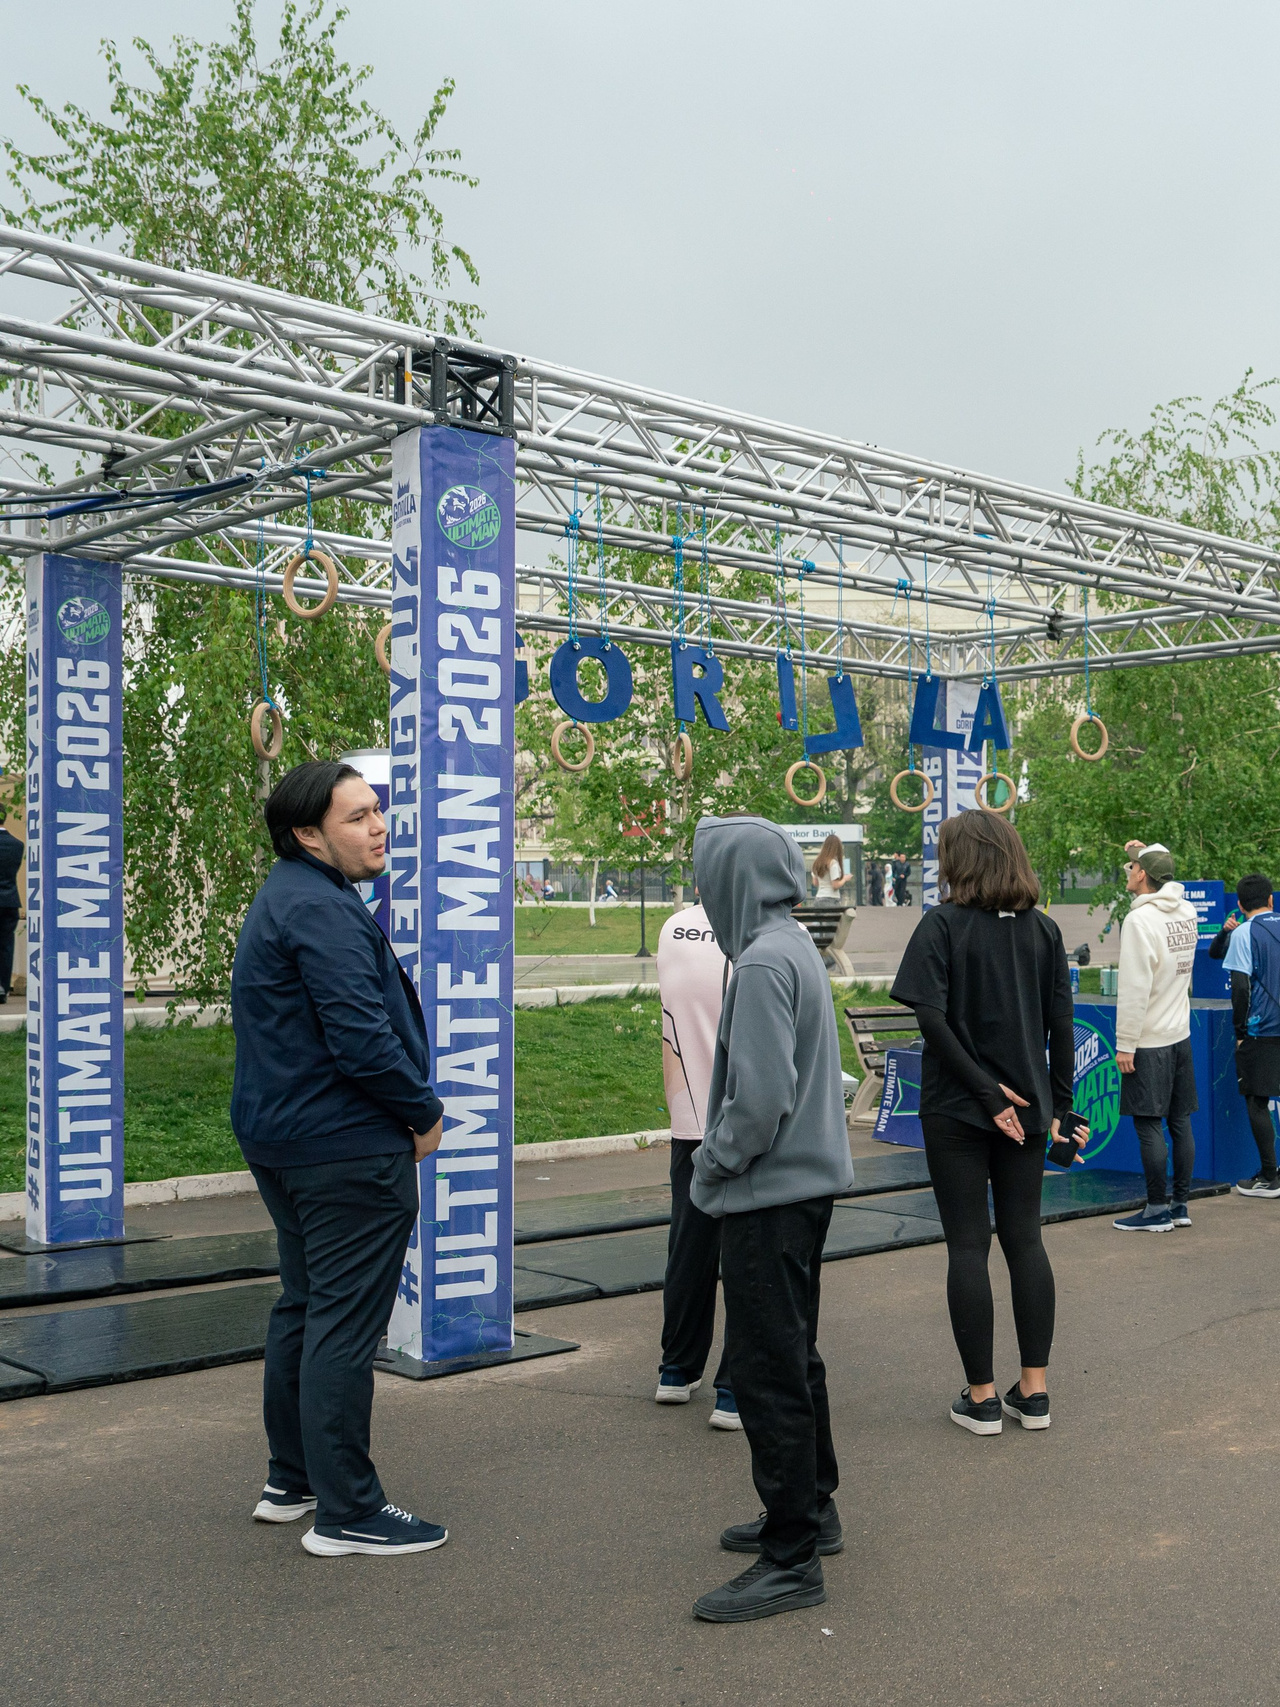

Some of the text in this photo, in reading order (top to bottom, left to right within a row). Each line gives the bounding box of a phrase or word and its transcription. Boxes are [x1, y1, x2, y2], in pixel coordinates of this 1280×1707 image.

[447, 505, 499, 542] ULTIMATE
[469, 493, 487, 513] 2026
[470, 519, 499, 547] MAN
[437, 565, 502, 746] 2026
[514, 630, 1012, 755] ORILLA
[812, 829, 837, 838] Bank
[922, 755, 943, 846] 2026
[437, 773, 501, 931] MAN
[57, 657, 113, 1201] ULTIMATE MAN 2026
[1190, 890, 1206, 899] MAN
[435, 962, 500, 1300] ULTIMATE
[876, 1058, 898, 1133] ULTIMATE MAN
